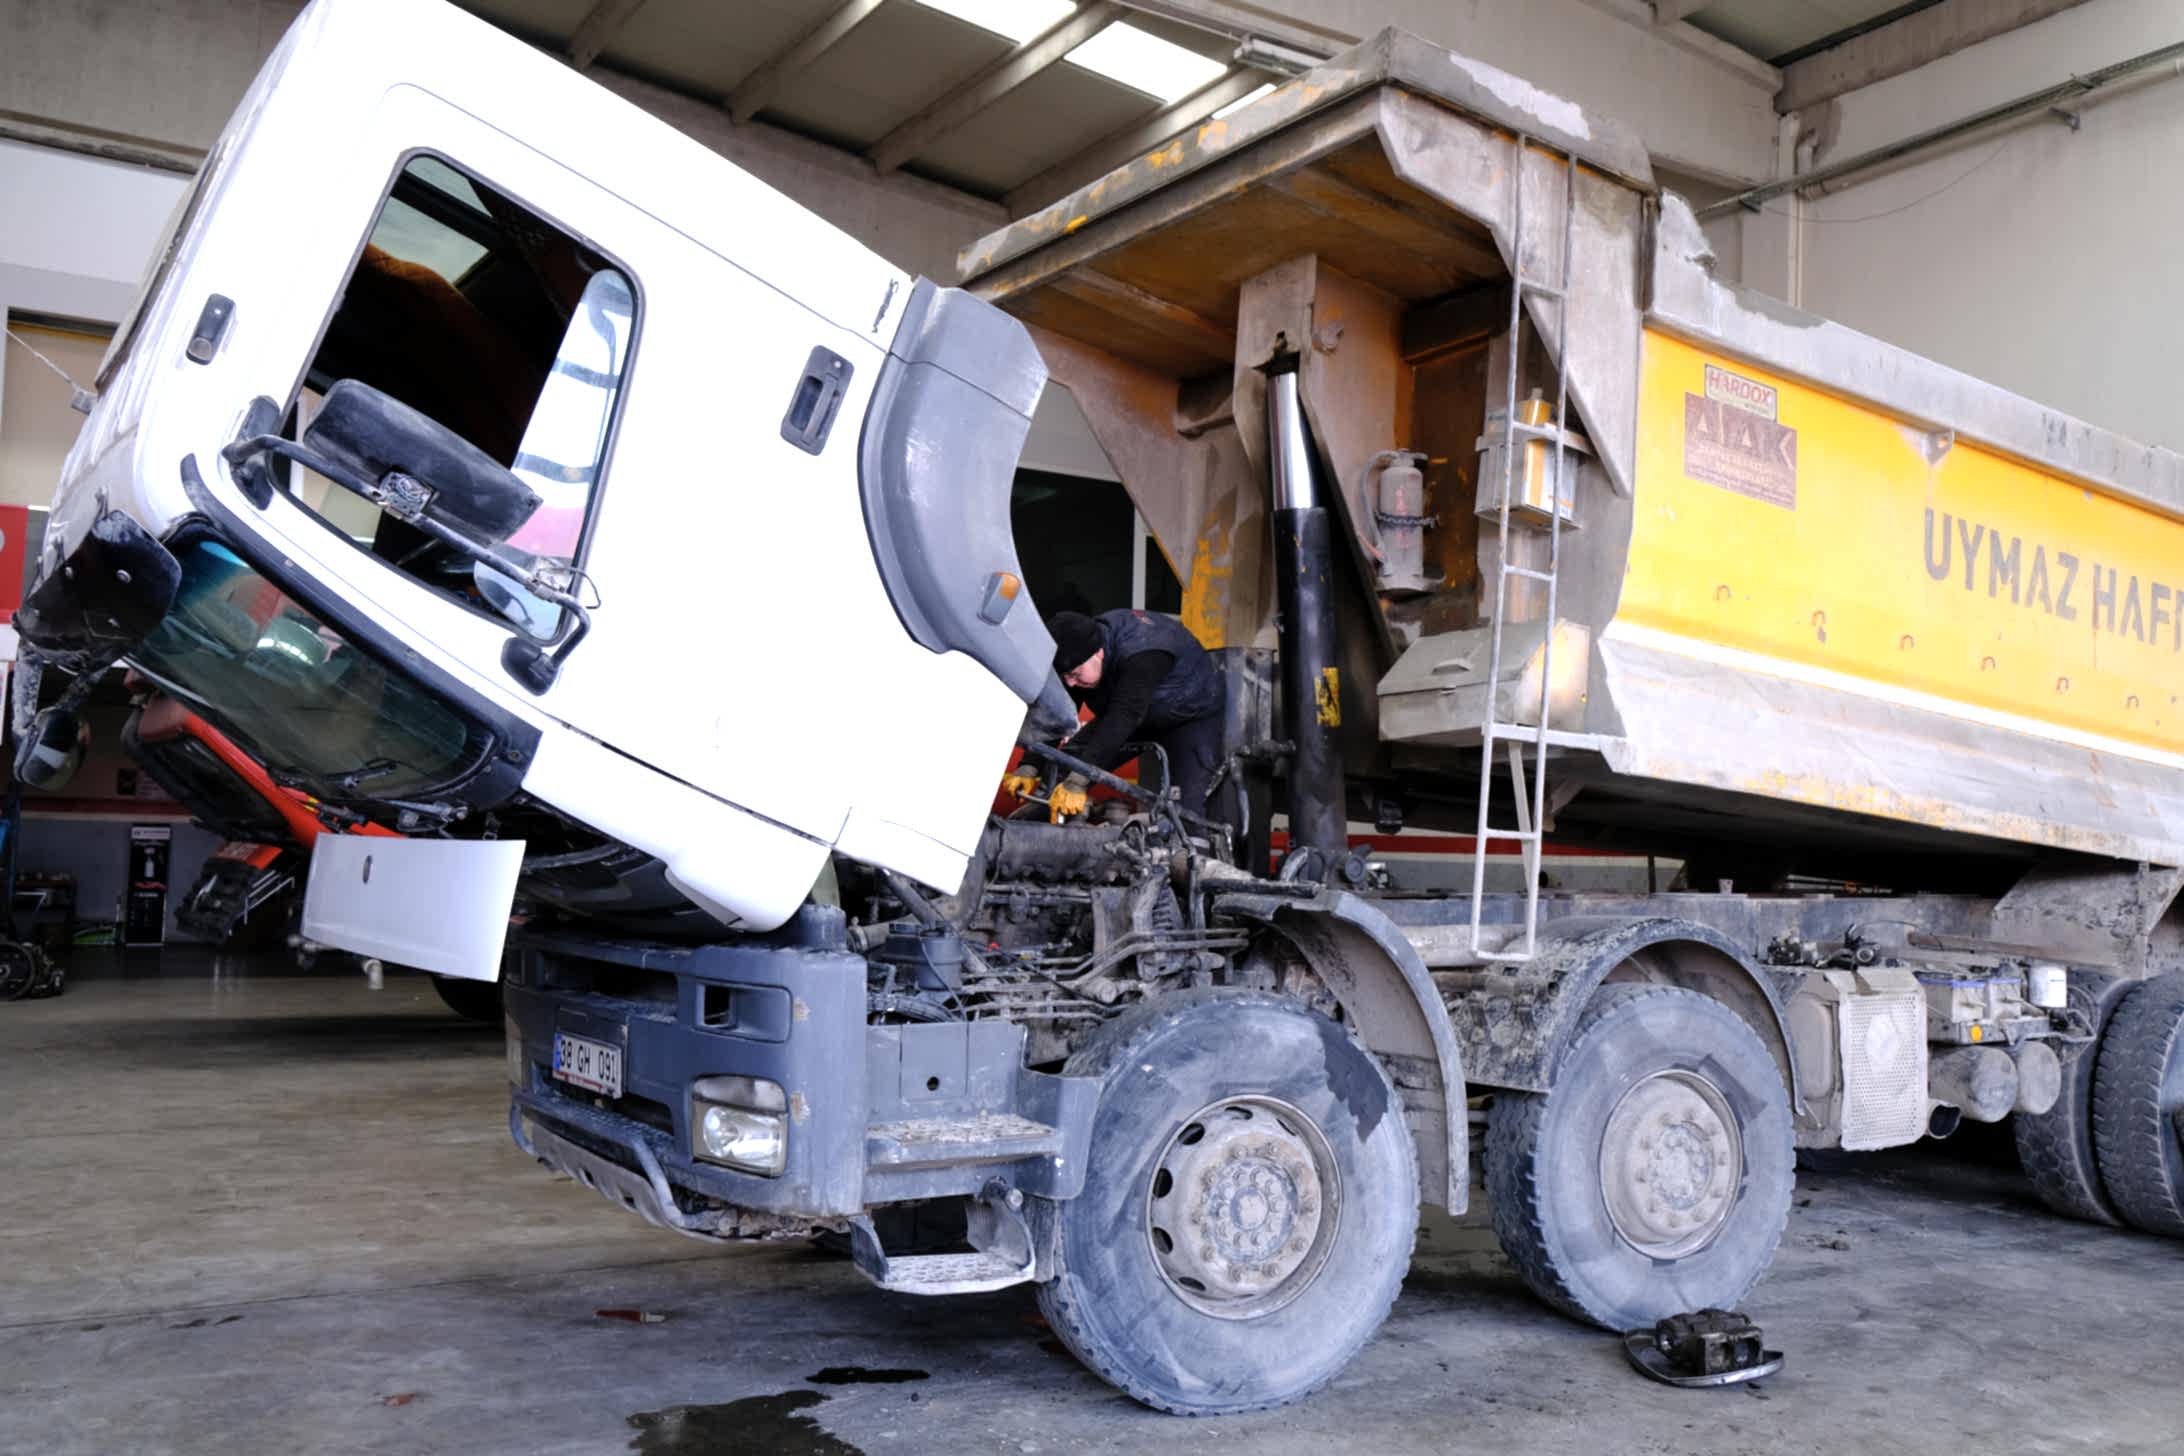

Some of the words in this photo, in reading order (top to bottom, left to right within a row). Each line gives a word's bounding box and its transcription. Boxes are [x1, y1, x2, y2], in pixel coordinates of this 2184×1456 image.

[1709, 370, 1771, 405] HARDOX
[1923, 506, 2080, 621] UYMAZ
[560, 1039, 573, 1069] 38
[577, 1044, 591, 1075] GH
[598, 1049, 617, 1084] 091
